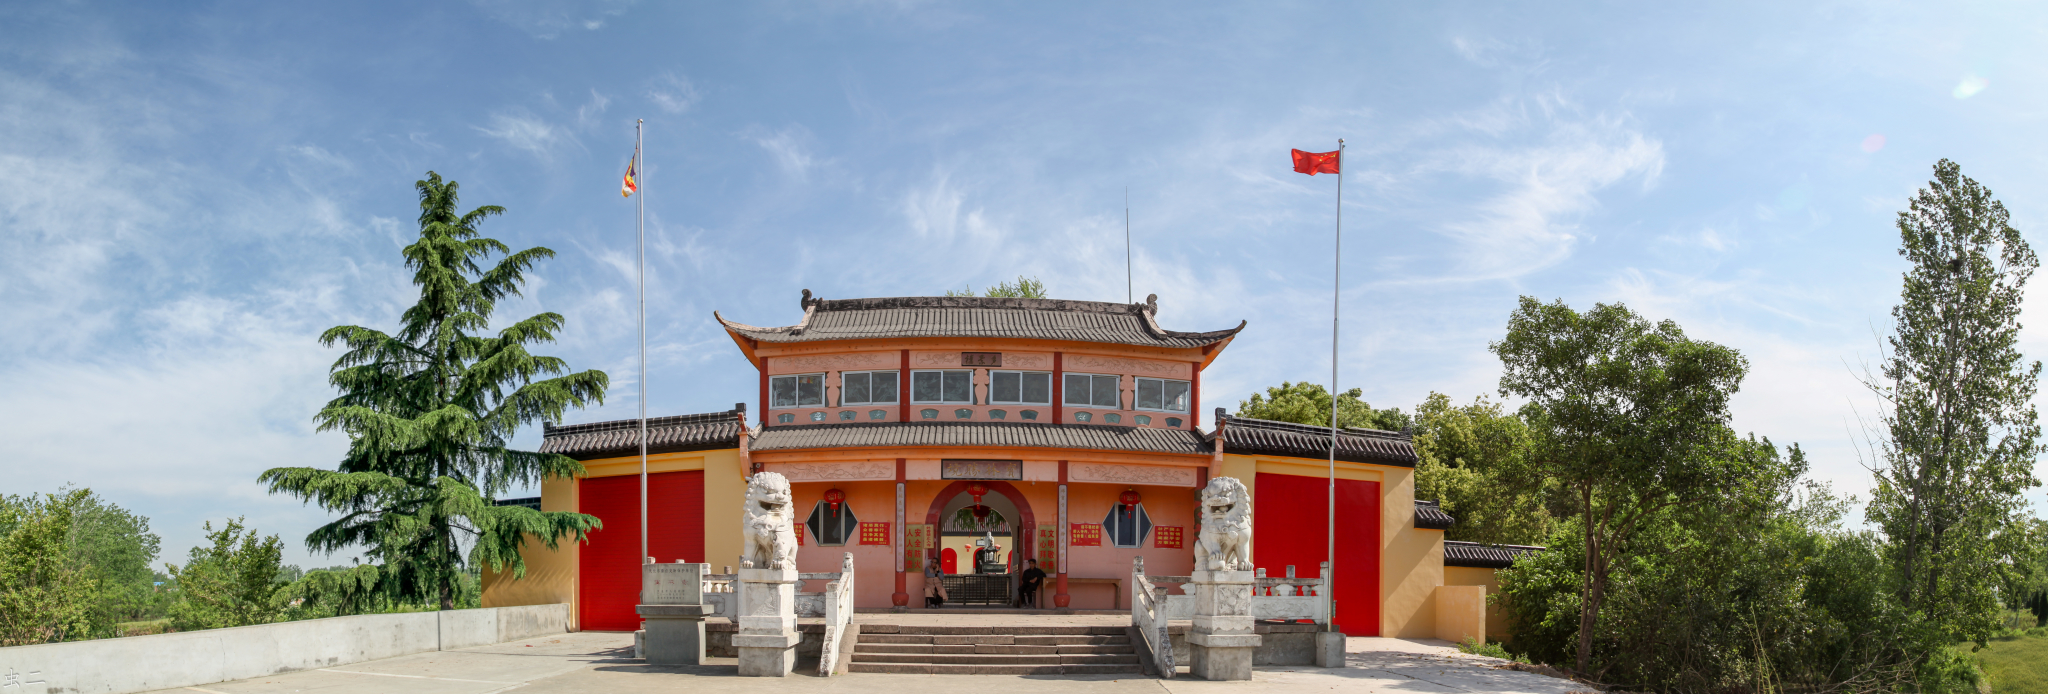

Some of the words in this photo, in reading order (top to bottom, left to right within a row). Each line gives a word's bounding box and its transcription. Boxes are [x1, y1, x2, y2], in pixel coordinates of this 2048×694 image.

[906, 528, 914, 569] 人人有责
[914, 528, 922, 569] 安全防火
[1039, 529, 1047, 570] 真心拜佛
[1047, 529, 1055, 570] 文明敬香
